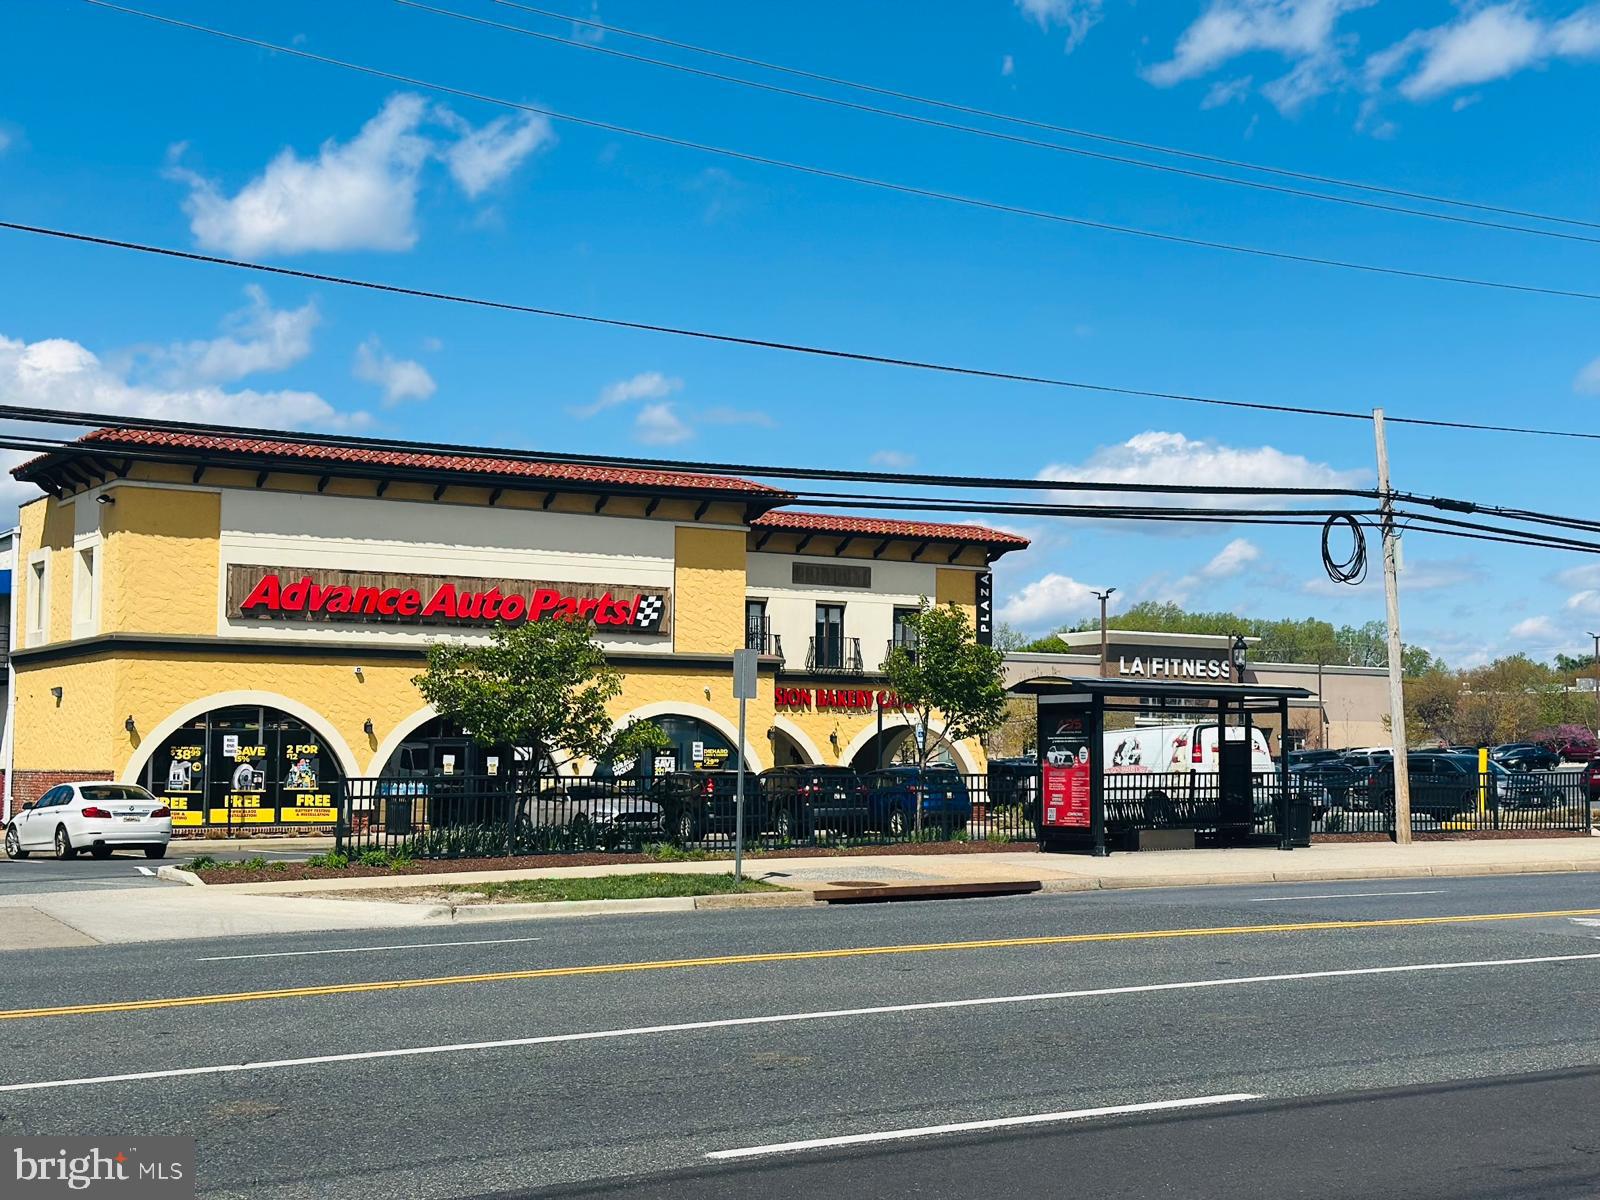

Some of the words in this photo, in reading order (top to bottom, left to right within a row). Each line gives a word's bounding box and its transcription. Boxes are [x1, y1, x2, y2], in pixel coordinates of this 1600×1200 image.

[240, 574, 421, 616] Advance
[420, 583, 526, 621] Auto
[526, 588, 631, 625] Parts
[980, 574, 990, 633] PLAZA
[1119, 656, 1145, 675] LA
[1152, 657, 1230, 679] FITNESS
[816, 689, 874, 708] BAKERY
[877, 690, 914, 709] CA
[235, 746, 266, 756] SAVE
[286, 744, 294, 754] 2
[295, 744, 319, 754] FOR
[158, 797, 188, 810] REE
[296, 794, 331, 807] FREE
